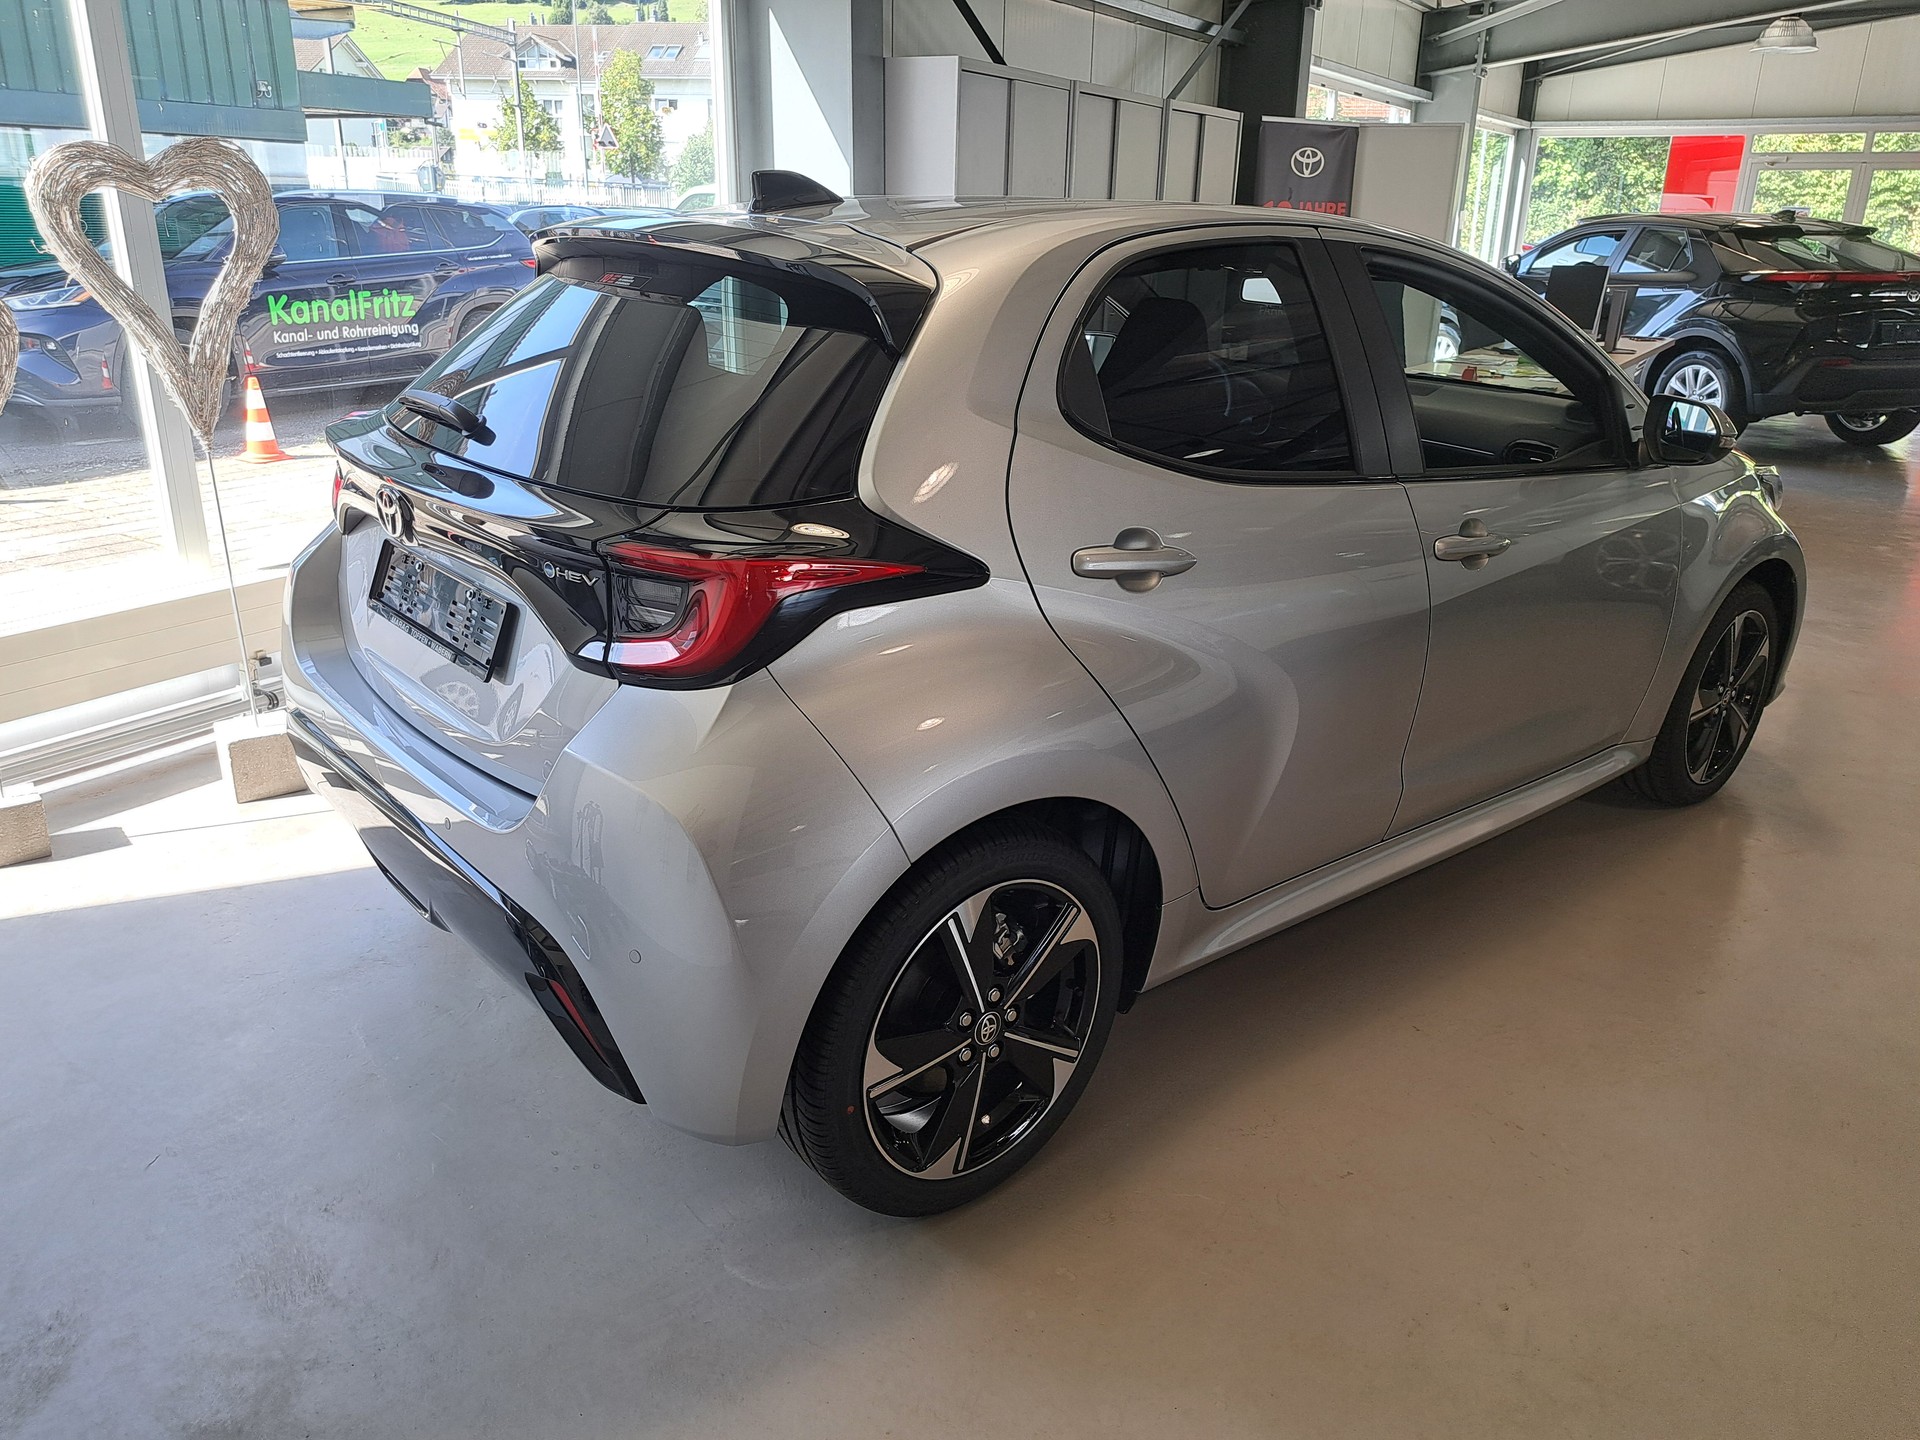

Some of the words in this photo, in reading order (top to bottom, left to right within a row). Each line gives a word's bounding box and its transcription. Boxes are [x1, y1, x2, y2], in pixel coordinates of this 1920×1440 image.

[267, 288, 416, 325] KanalFritz
[273, 328, 313, 344] Kanal-
[317, 325, 339, 341] und
[342, 323, 419, 338] Rohrreinigung
[556, 567, 599, 586] HEV
